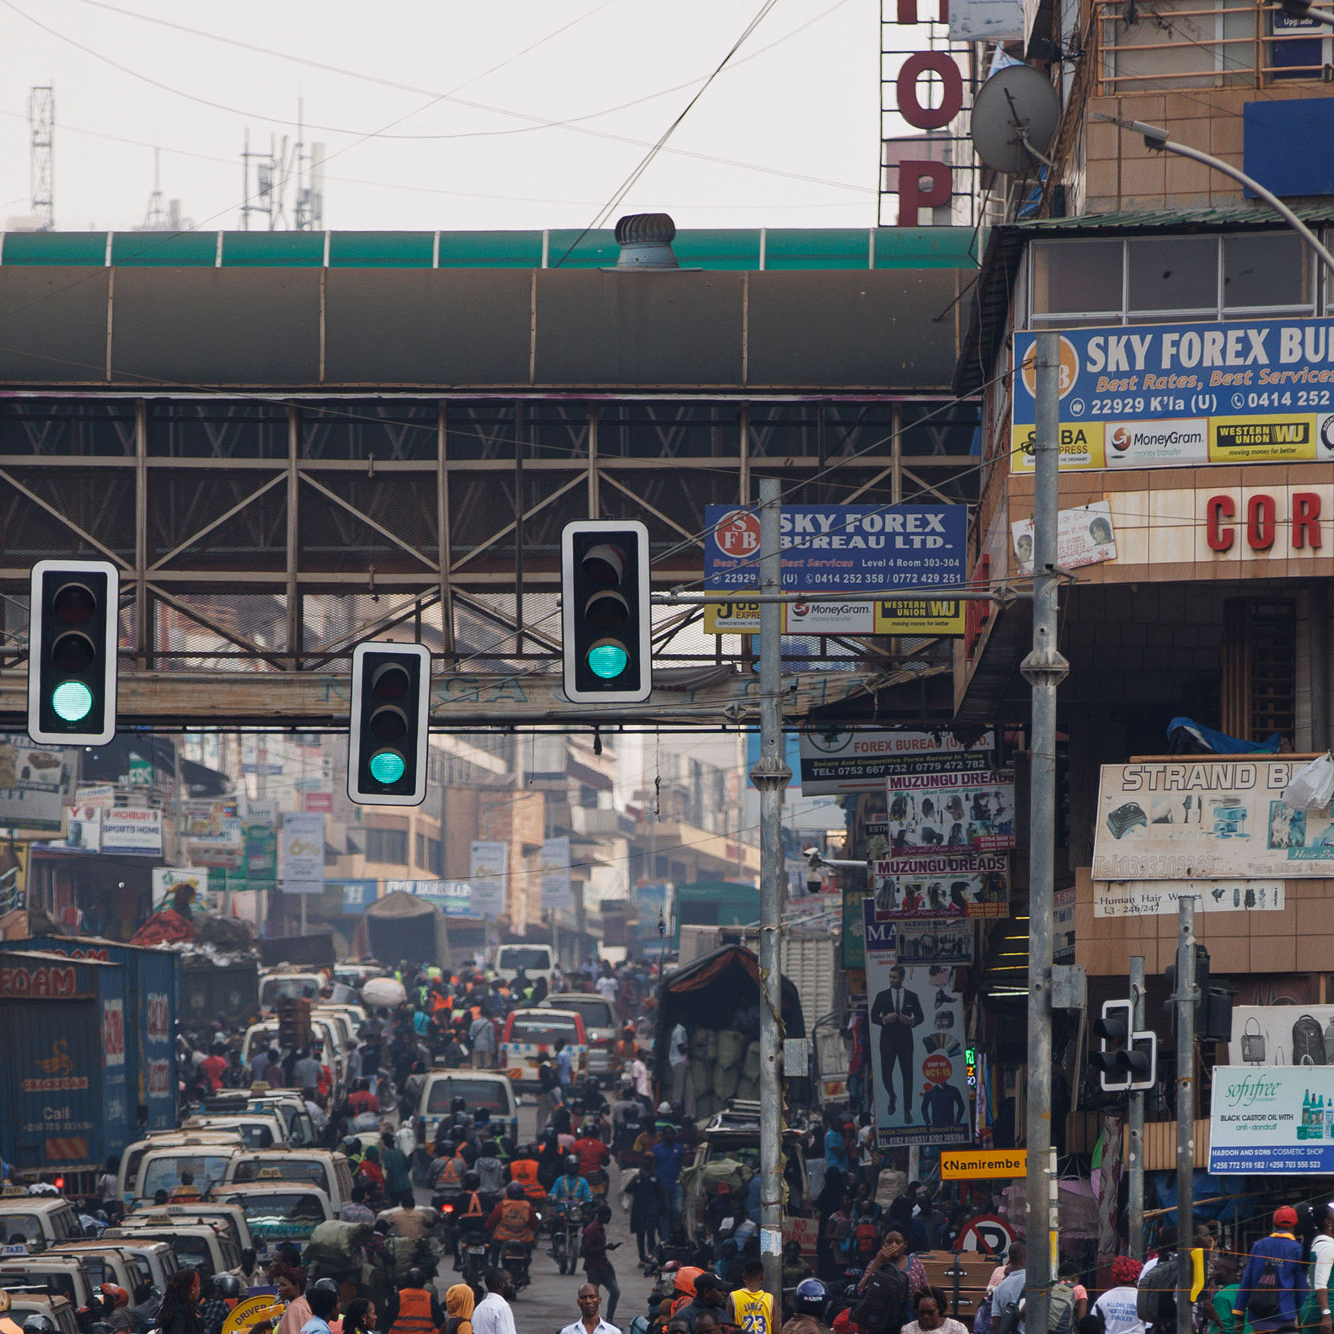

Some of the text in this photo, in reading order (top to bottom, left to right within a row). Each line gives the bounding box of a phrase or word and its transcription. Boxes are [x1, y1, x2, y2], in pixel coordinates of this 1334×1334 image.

[1086, 334, 1153, 373] SKY
[1161, 328, 1270, 370] FOREX
[1095, 375, 1138, 393] Best
[1142, 374, 1203, 391] Rates,
[1208, 370, 1252, 387] Best
[1091, 398, 1144, 414] 22929
[1191, 394, 1218, 413] (U)
[1248, 391, 1292, 407] 0414
[1297, 390, 1330, 406] 252
[1219, 425, 1270, 437] WESTERN
[1235, 434, 1270, 444] UNION
[1228, 449, 1250, 457] moving
[780, 513, 946, 534] SKY FOREX
[780, 535, 954, 549] BUREAU LTD.
[806, 558, 960, 568] Services Level Room 303-304
[814, 573, 962, 584] 0414 252 358 0772 429 251
[883, 600, 927, 609] WESTERN
[896, 608, 927, 617] UNION
[838, 766, 864, 775] 0752
[890, 774, 959, 789] MUZUNGU
[1122, 763, 1258, 791] STRAND
[102, 824, 160, 835] SPORTS HOME
[878, 857, 1005, 874] MUZUNGU DREADS
[1100, 893, 1163, 906] Human Hair
[1220, 1113, 1294, 1122] BLACK CASTOR WITH
[1212, 1149, 1239, 1157] HAROON
[1272, 1148, 1305, 1156] COSMETIC
[1306, 1148, 1324, 1156] SHOP
[950, 1158, 1021, 1171] Namirembe
[793, 1219, 807, 1232] NO
[5, 1245, 24, 1253] TAXI
[743, 1302, 764, 1312] JAMES
